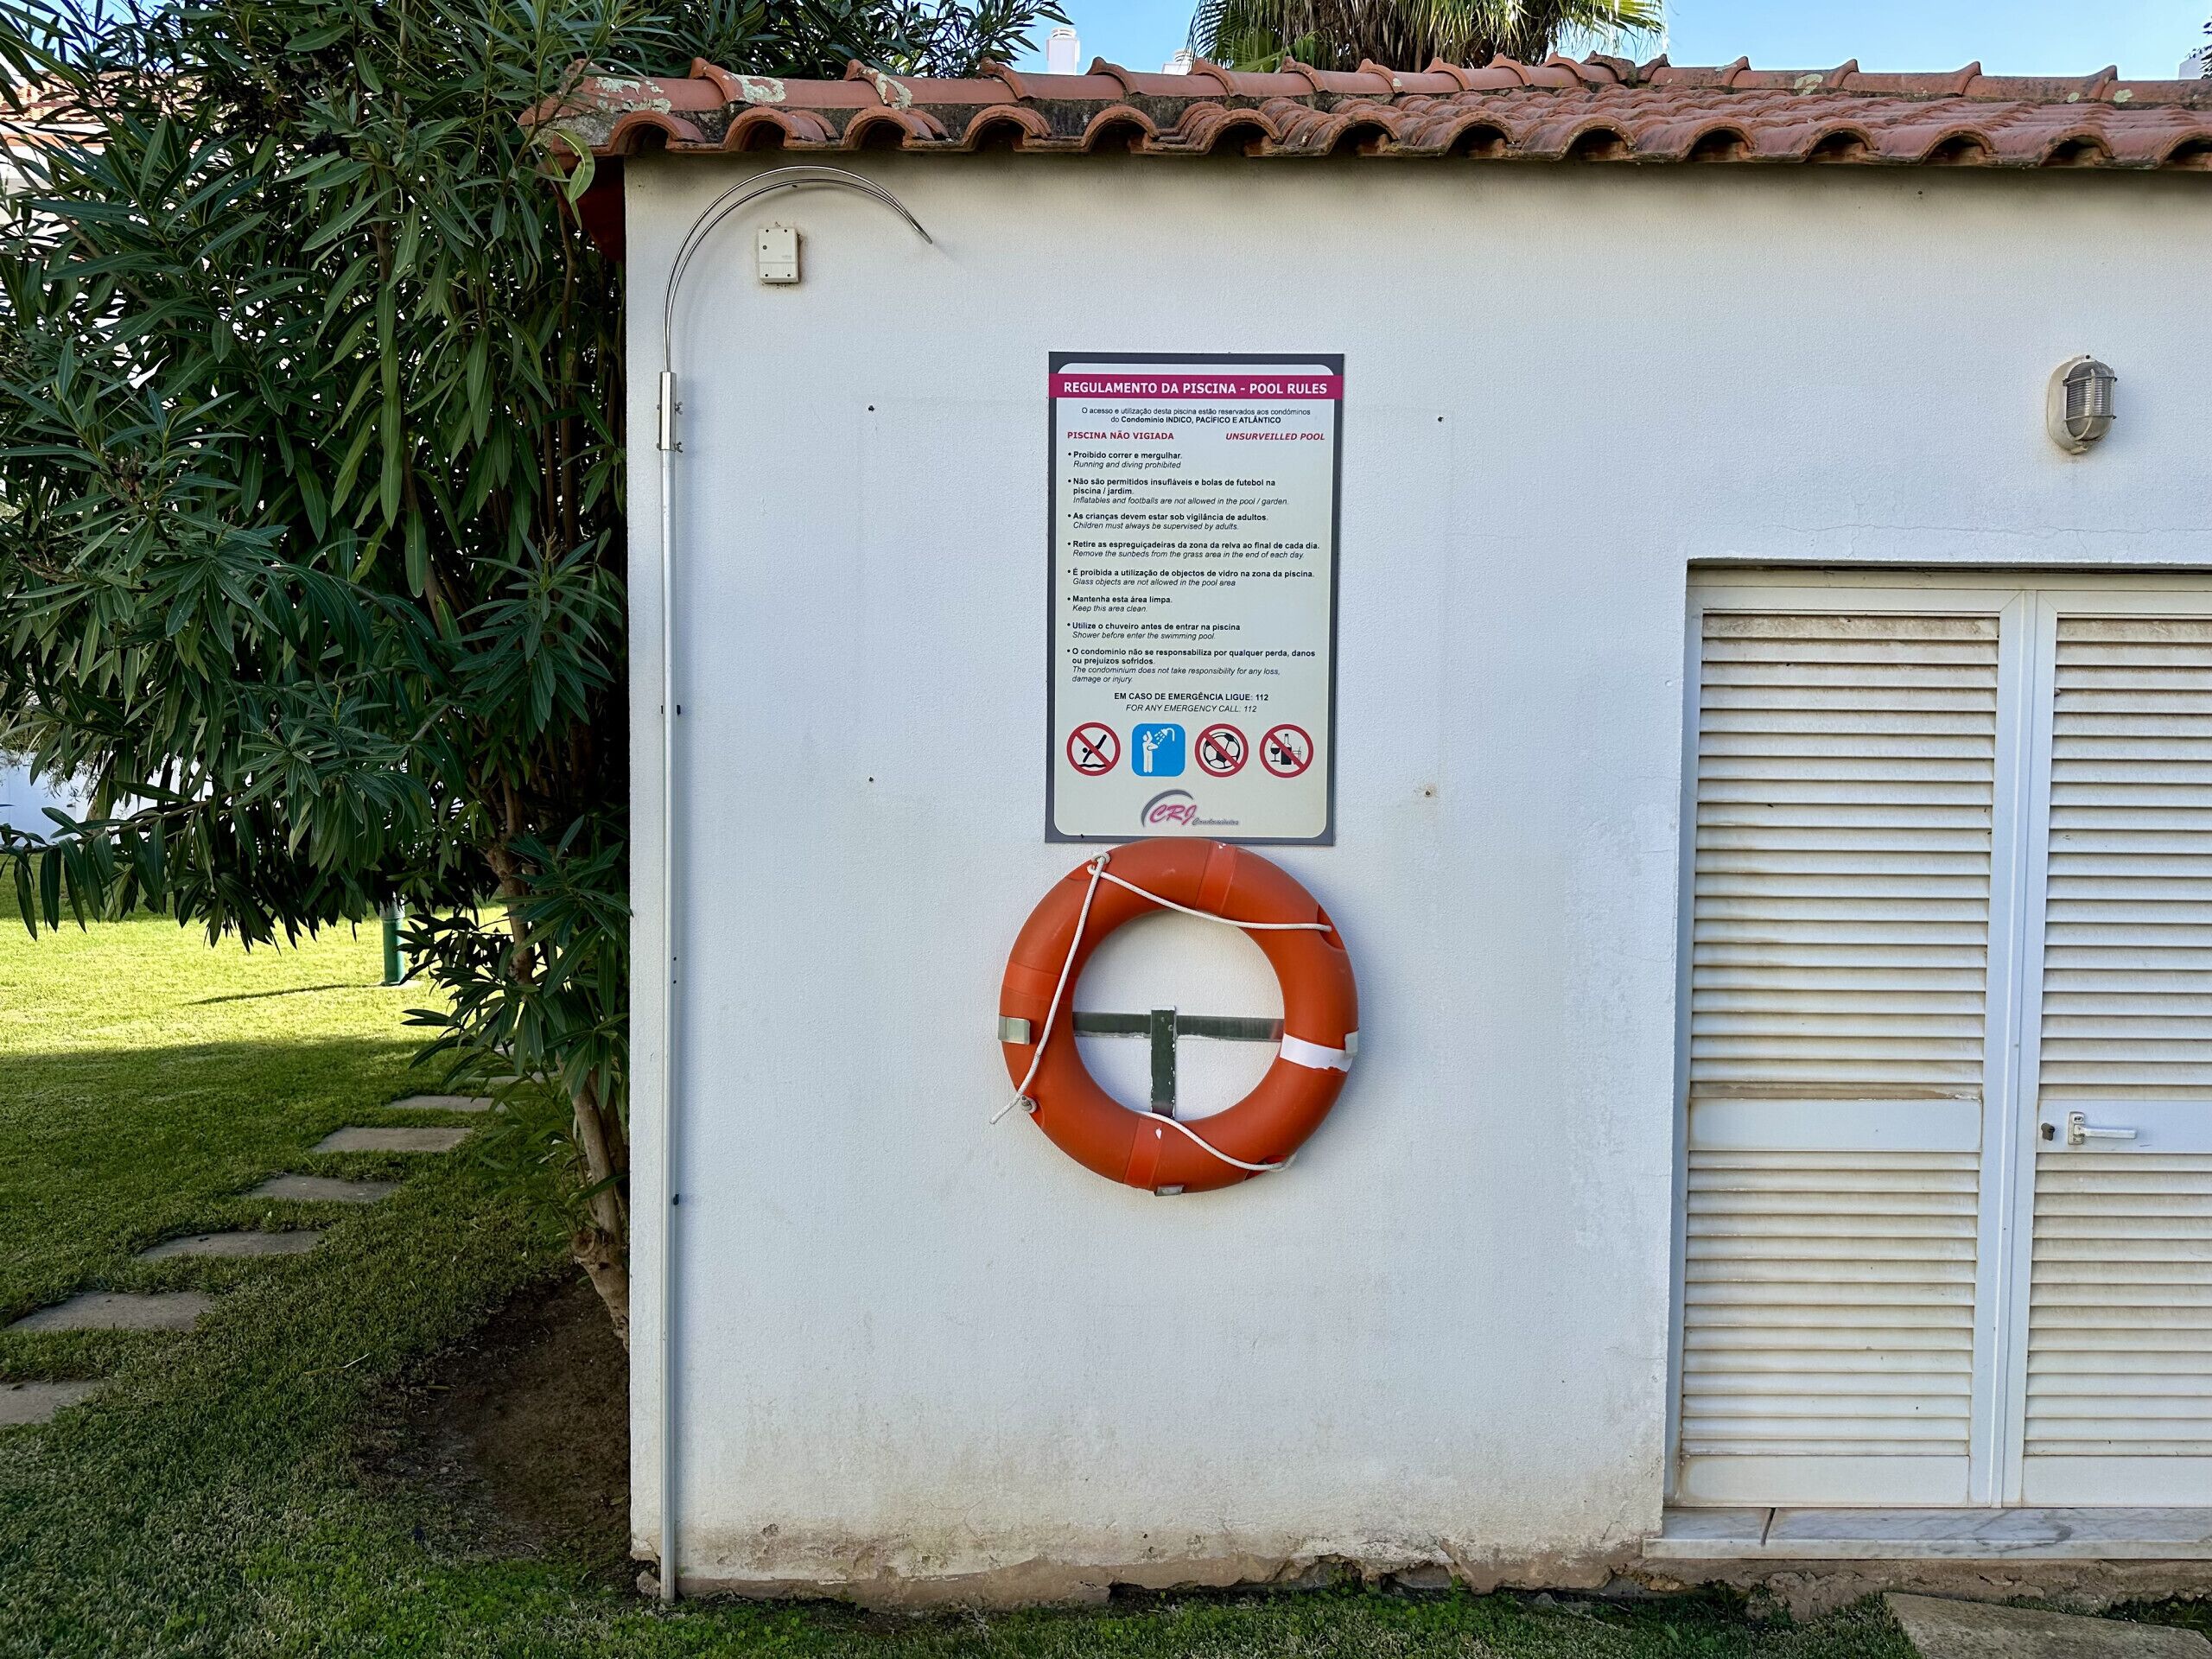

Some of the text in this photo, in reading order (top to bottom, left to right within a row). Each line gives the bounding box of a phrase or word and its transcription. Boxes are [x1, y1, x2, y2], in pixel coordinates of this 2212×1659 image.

[1064, 382, 1327, 394] REGULAMENTO DA PISCINA POOL RULES
[1121, 407, 1152, 416] utilização
[1173, 407, 1197, 416] piscina
[1239, 415, 1281, 423] ATLÂNTICO
[1109, 430, 1130, 440] NÃO
[1073, 461, 1104, 469] Running
[1122, 461, 1143, 469] diving
[1145, 461, 1181, 469] prohibited
[1107, 478, 1148, 486] permitidos
[1073, 486, 1101, 495] piscina
[1239, 498, 1255, 506] pool
[1085, 512, 1118, 521] crianças
[1125, 522, 1150, 531] always
[1163, 522, 1203, 531] supervised
[1205, 522, 1214, 531] by
[1109, 541, 1175, 550] espreguiçadeiras
[1080, 569, 1112, 577] proibida
[1121, 569, 1158, 577] utilização
[1172, 569, 1205, 578] objectos
[1095, 578, 1122, 587] objects
[1201, 579, 1218, 588] pool
[1072, 604, 1091, 613] Keep
[1212, 623, 1240, 632] piscina
[1160, 632, 1197, 640] swimming
[1156, 648, 1211, 657] responsabiliza
[1229, 649, 1263, 658] qualquer
[1188, 667, 1235, 676] responsibility
[1071, 675, 1101, 683] damage
[1168, 691, 1224, 701] EMERGÊNCIA
